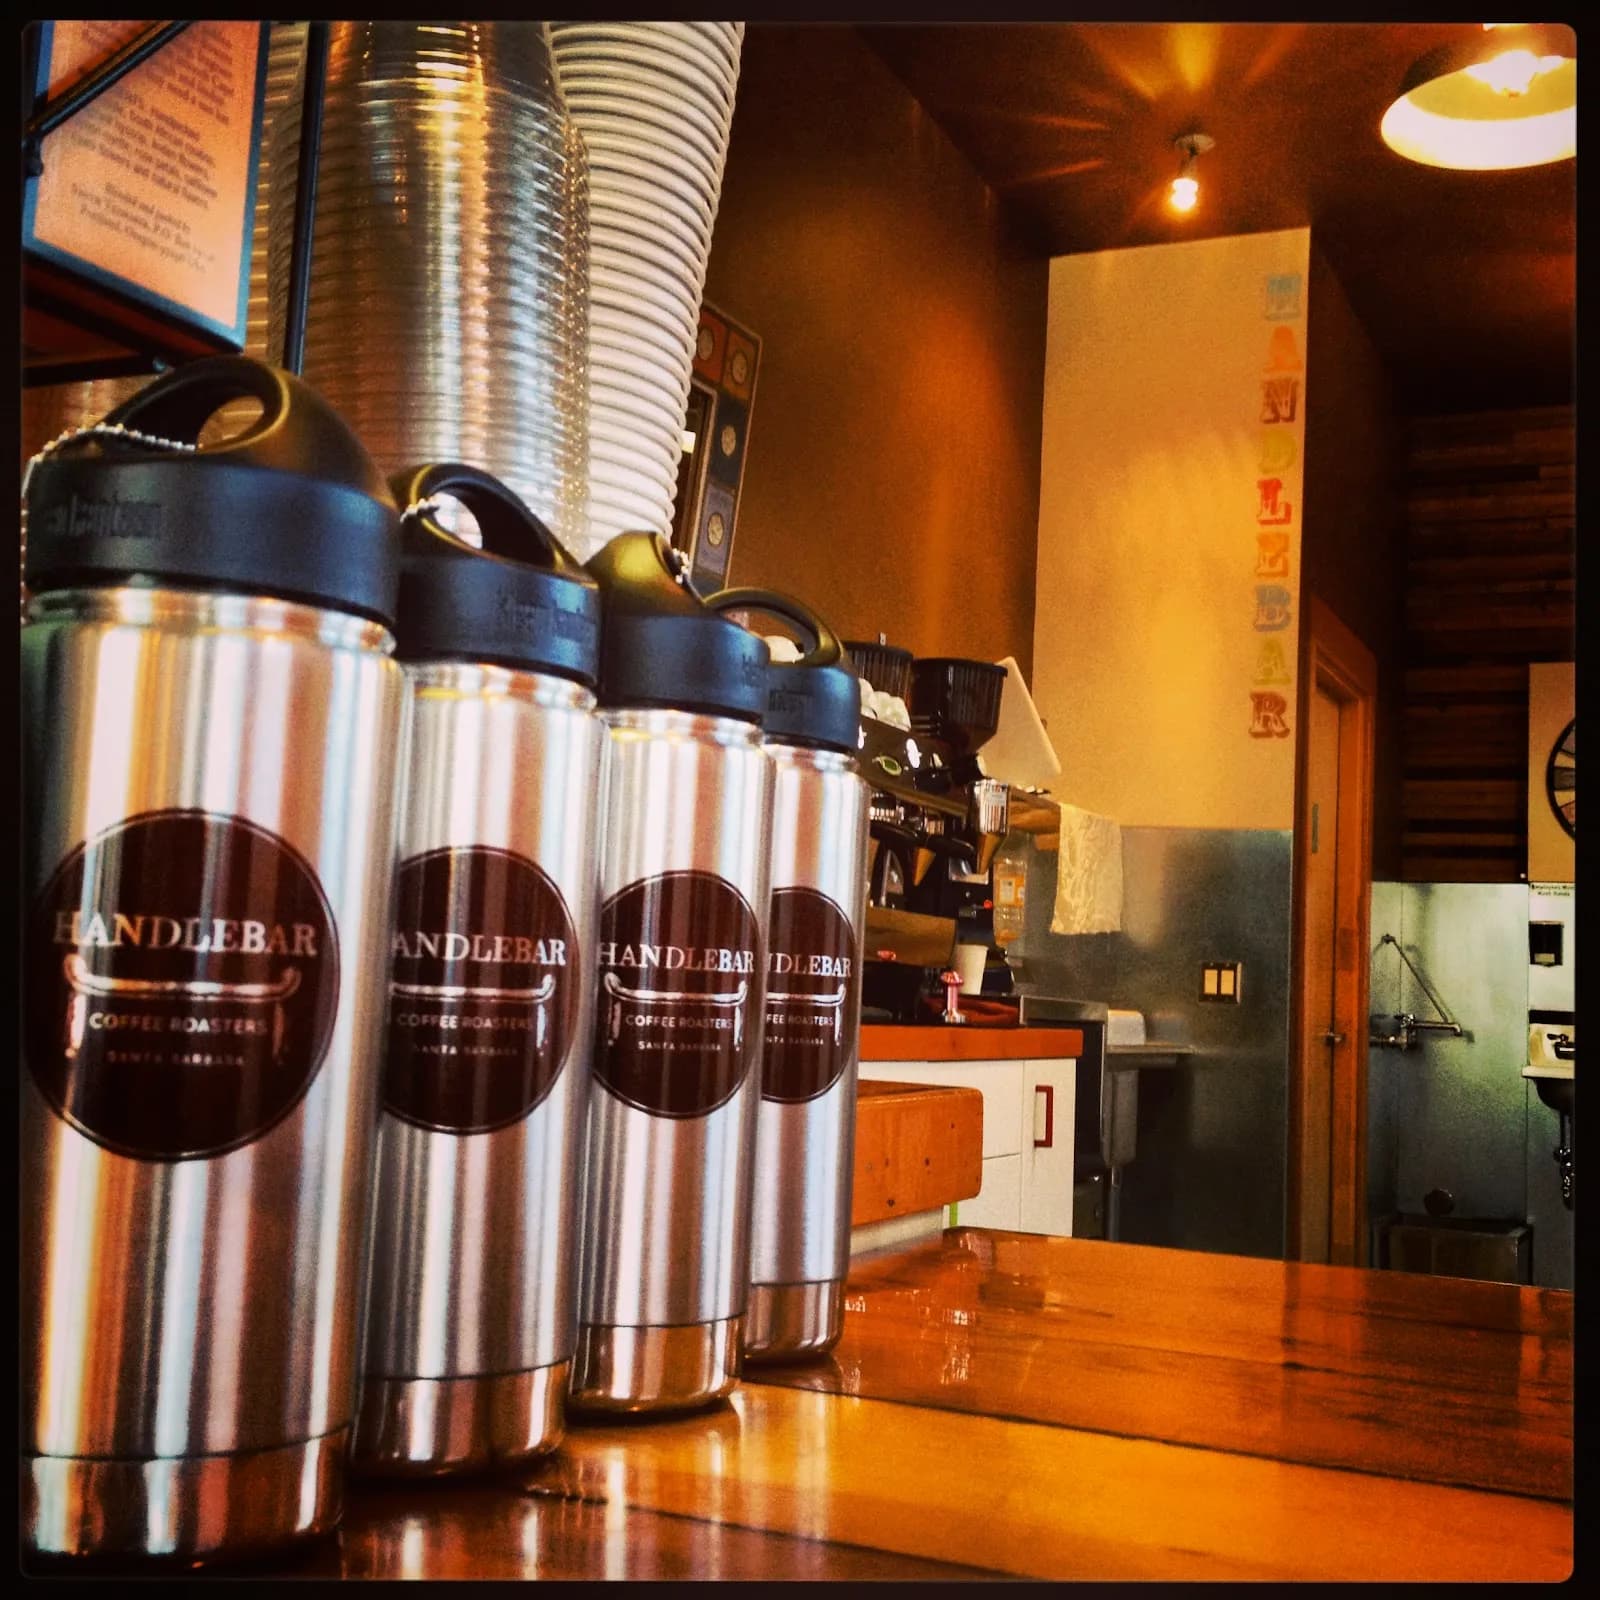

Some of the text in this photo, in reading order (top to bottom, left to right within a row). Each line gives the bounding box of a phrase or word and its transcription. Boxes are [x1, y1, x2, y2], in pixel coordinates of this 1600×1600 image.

[53, 909, 318, 957] HANDLEBAR
[598, 941, 754, 974] HANDLEBAR
[89, 1012, 268, 1036] COFFEE ROASTERS
[397, 1013, 533, 1031] COFFEE ROASTERS
[625, 1014, 734, 1030] COFFEE ROASTERS
[788, 1014, 834, 1027] ROASTERS
[637, 1040, 676, 1051] SANTA
